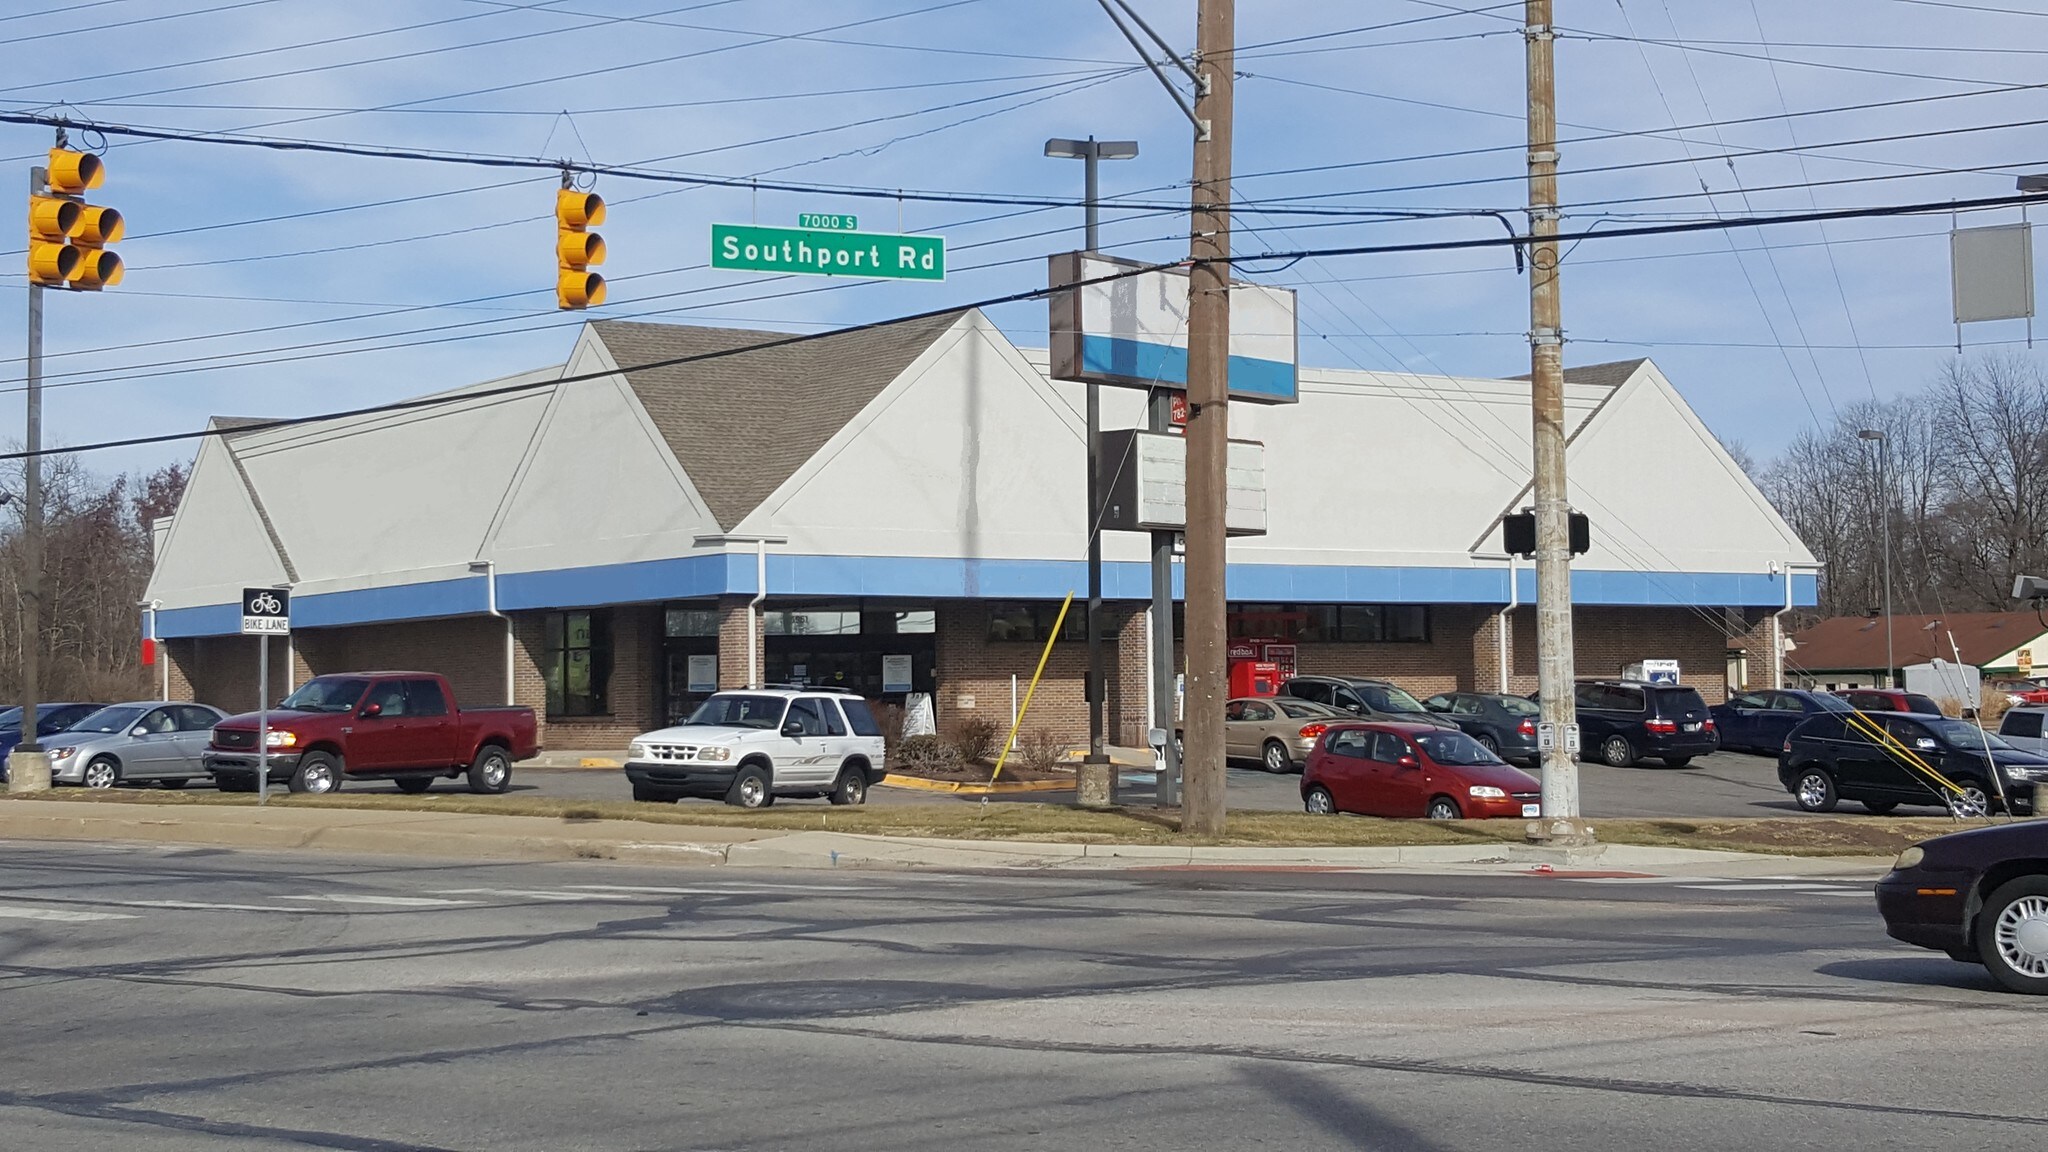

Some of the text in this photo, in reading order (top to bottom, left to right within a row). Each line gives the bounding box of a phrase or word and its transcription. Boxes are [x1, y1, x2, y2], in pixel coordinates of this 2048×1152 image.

[803, 214, 855, 230] 7000 S
[722, 235, 935, 270] Southport Rd
[244, 618, 287, 631] BIKE LANE
